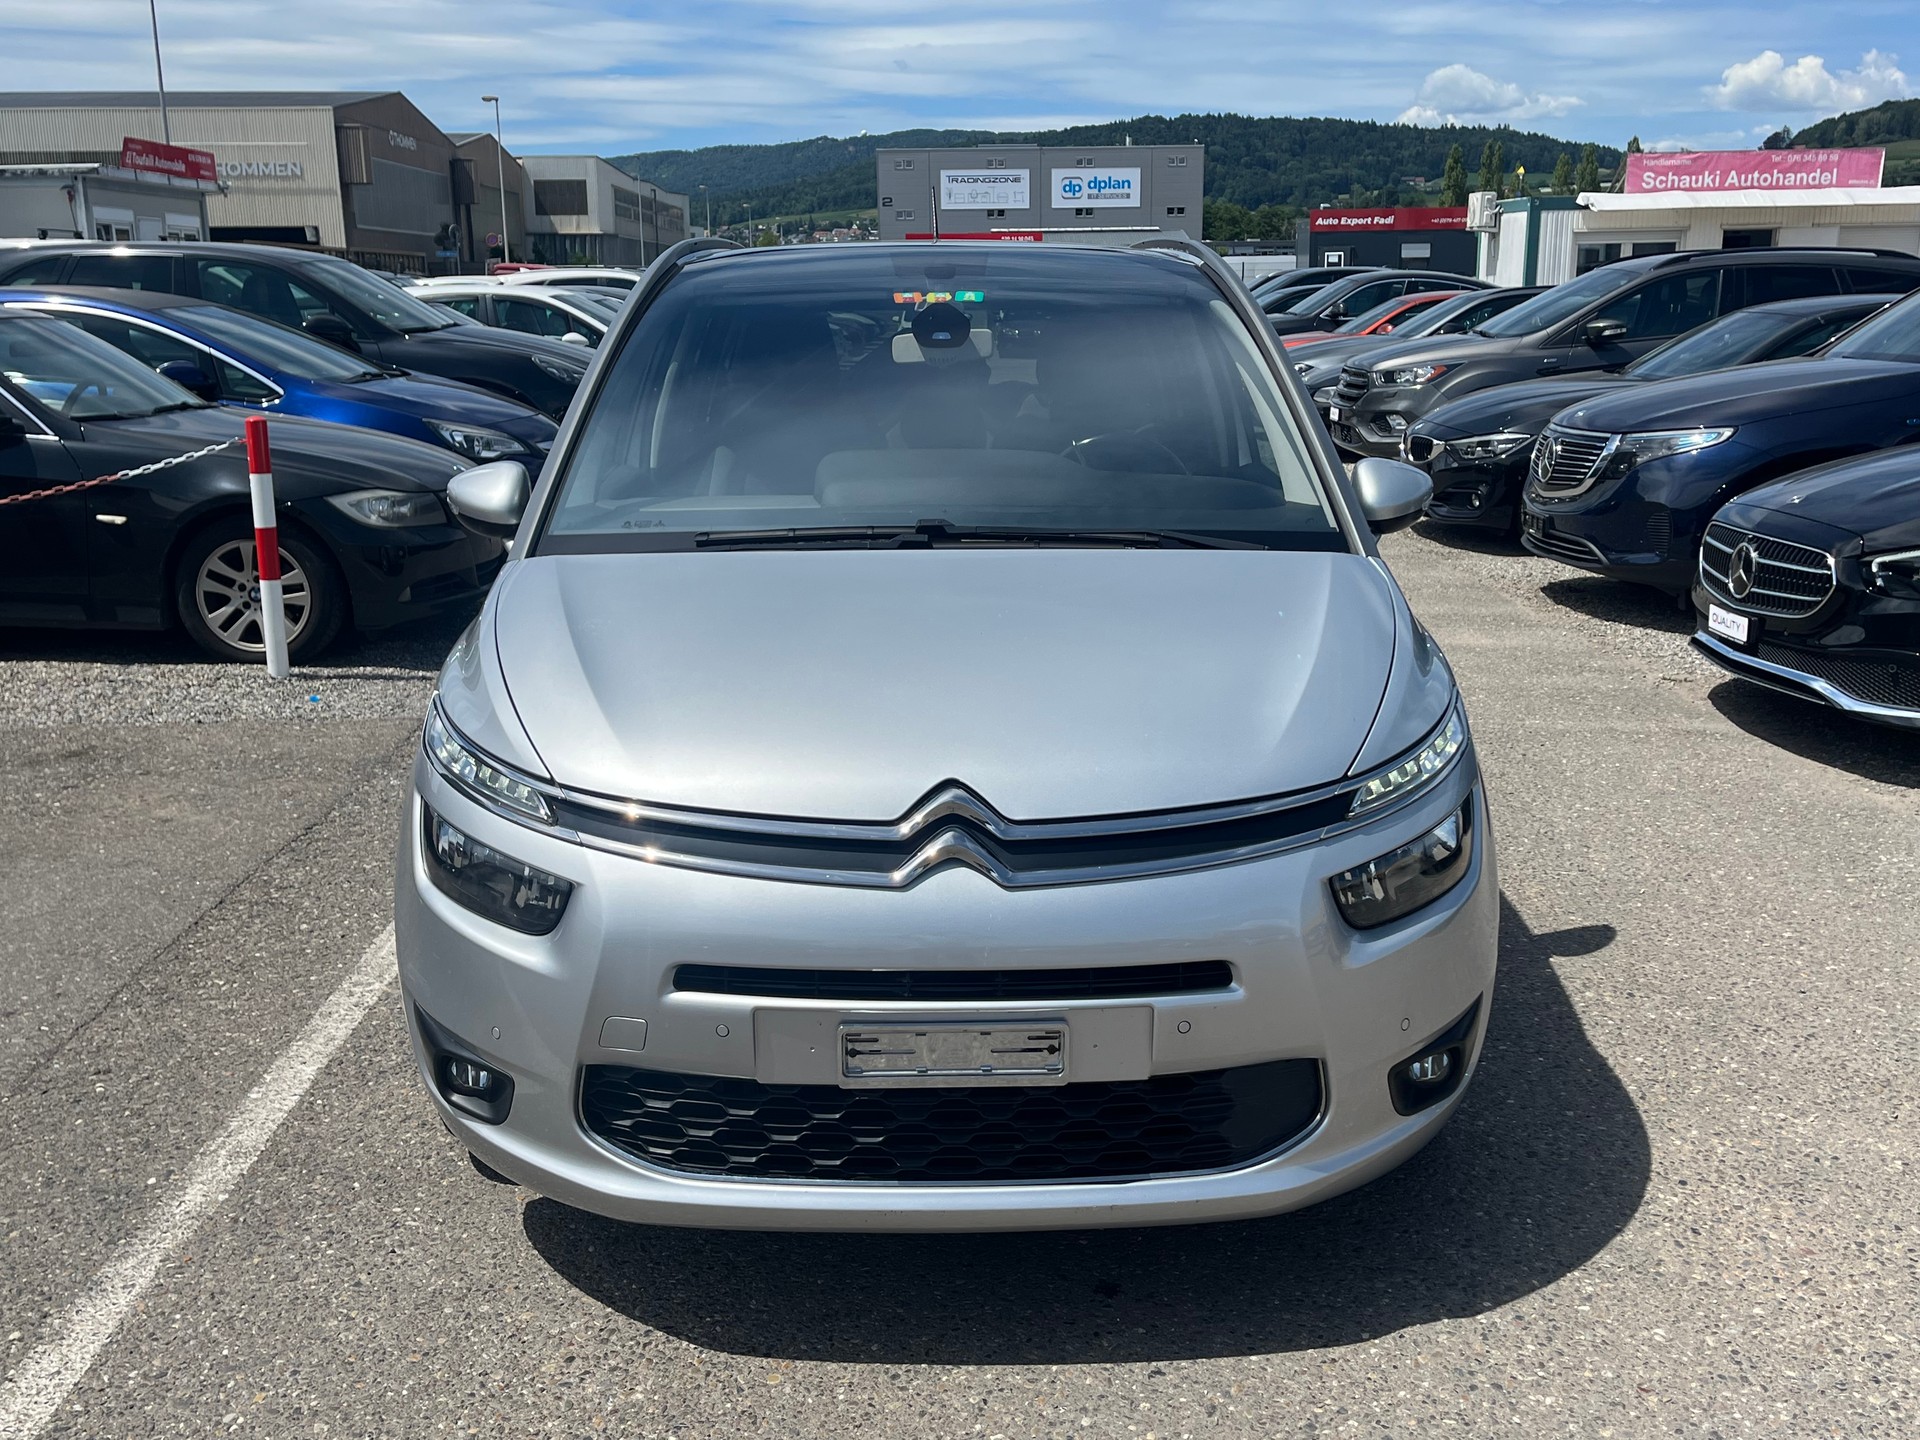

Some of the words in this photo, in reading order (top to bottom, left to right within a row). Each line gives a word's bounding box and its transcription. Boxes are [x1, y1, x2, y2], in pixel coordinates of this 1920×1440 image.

[217, 162, 302, 176] HOMMEN
[946, 175, 1021, 184] TRADINGZONE
[1087, 176, 1131, 193] dplan
[1641, 170, 1721, 189] Schauki
[1724, 167, 1838, 188] Autohandel
[1062, 180, 1082, 196] dp
[882, 197, 893, 207] 2
[1315, 217, 1339, 226] Auto
[1340, 216, 1373, 227] Export
[1373, 215, 1395, 225] Fadi
